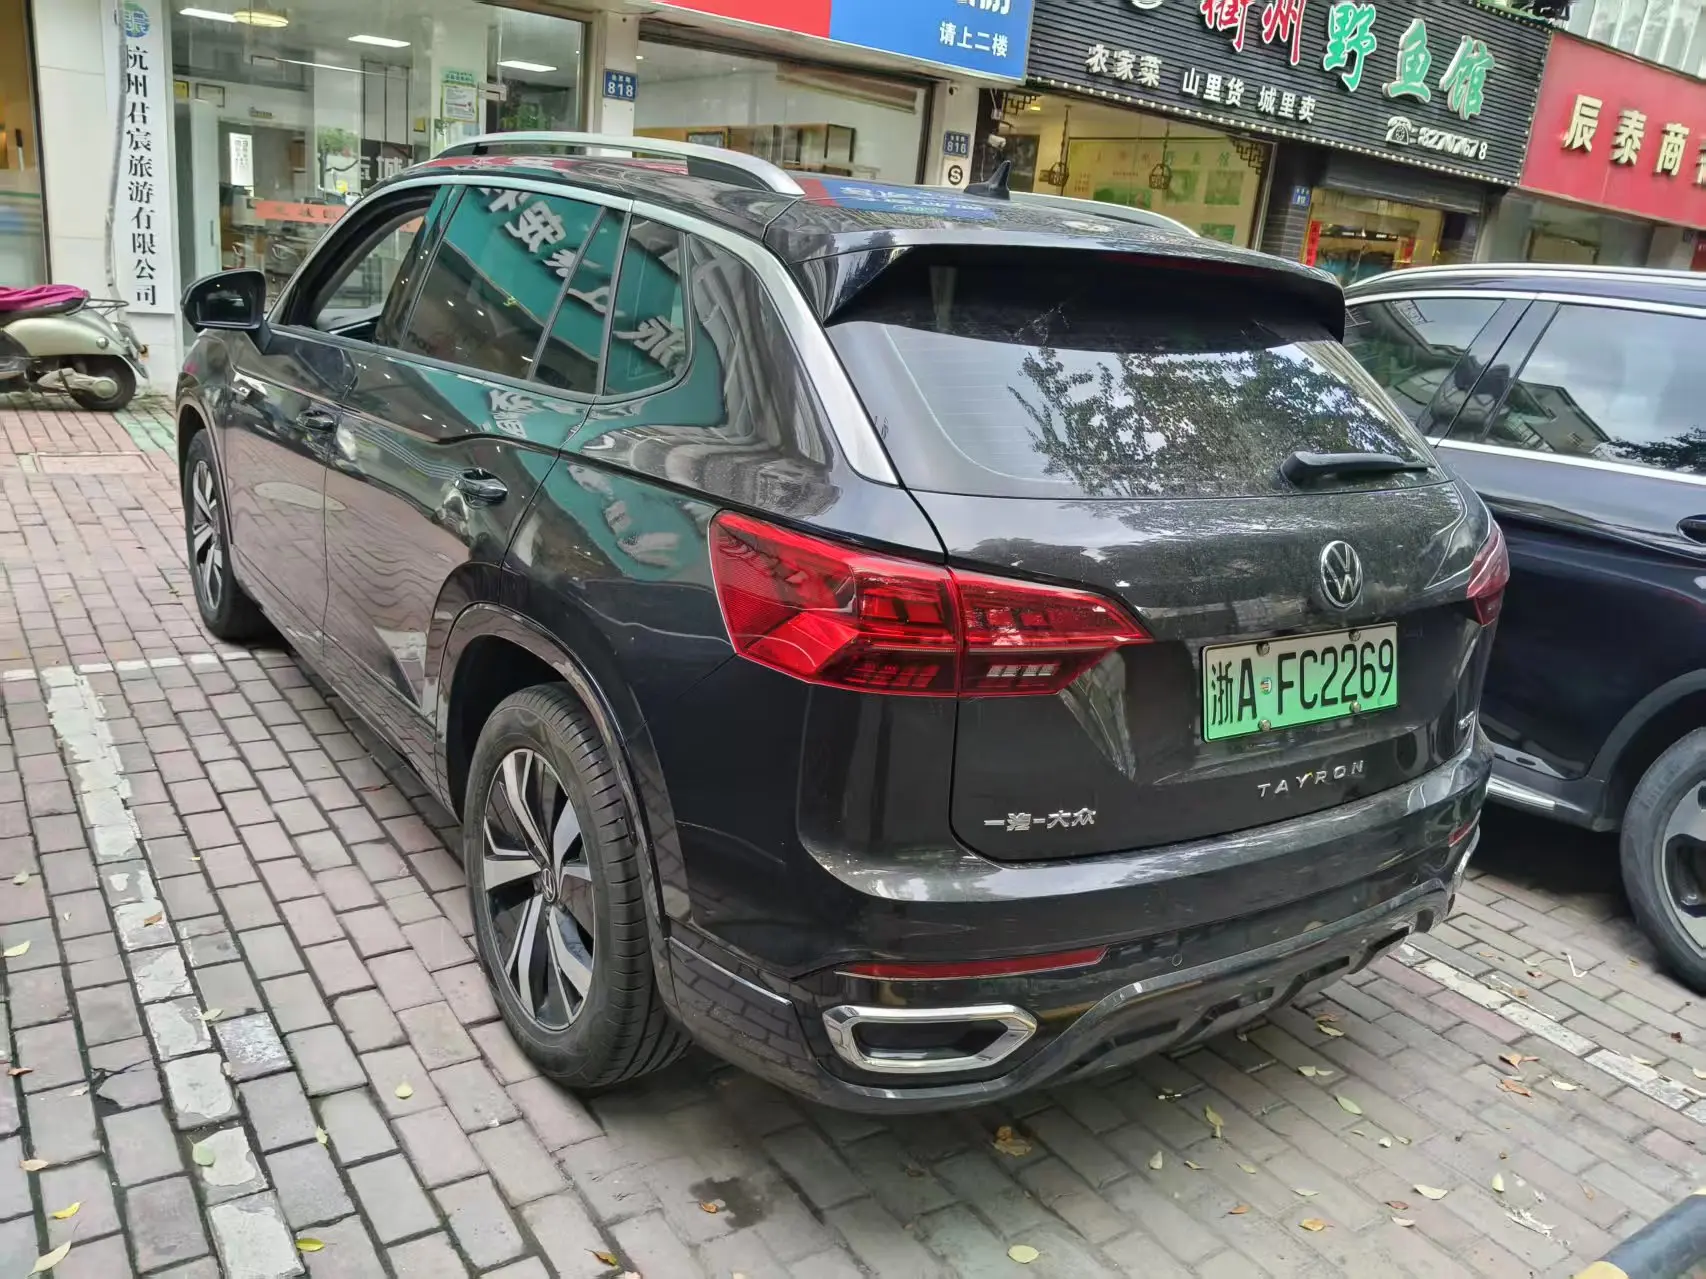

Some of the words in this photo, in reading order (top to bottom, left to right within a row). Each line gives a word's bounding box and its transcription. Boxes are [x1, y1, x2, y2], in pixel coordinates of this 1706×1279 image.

[939, 21, 1009, 58] 请上二楼
[607, 81, 634, 97] 818
[1085, 44, 1162, 88] 农家菜
[1182, 67, 1245, 108] 山里货
[1257, 85, 1317, 124] 城里卖
[1256, 759, 1365, 798] TAYRON
